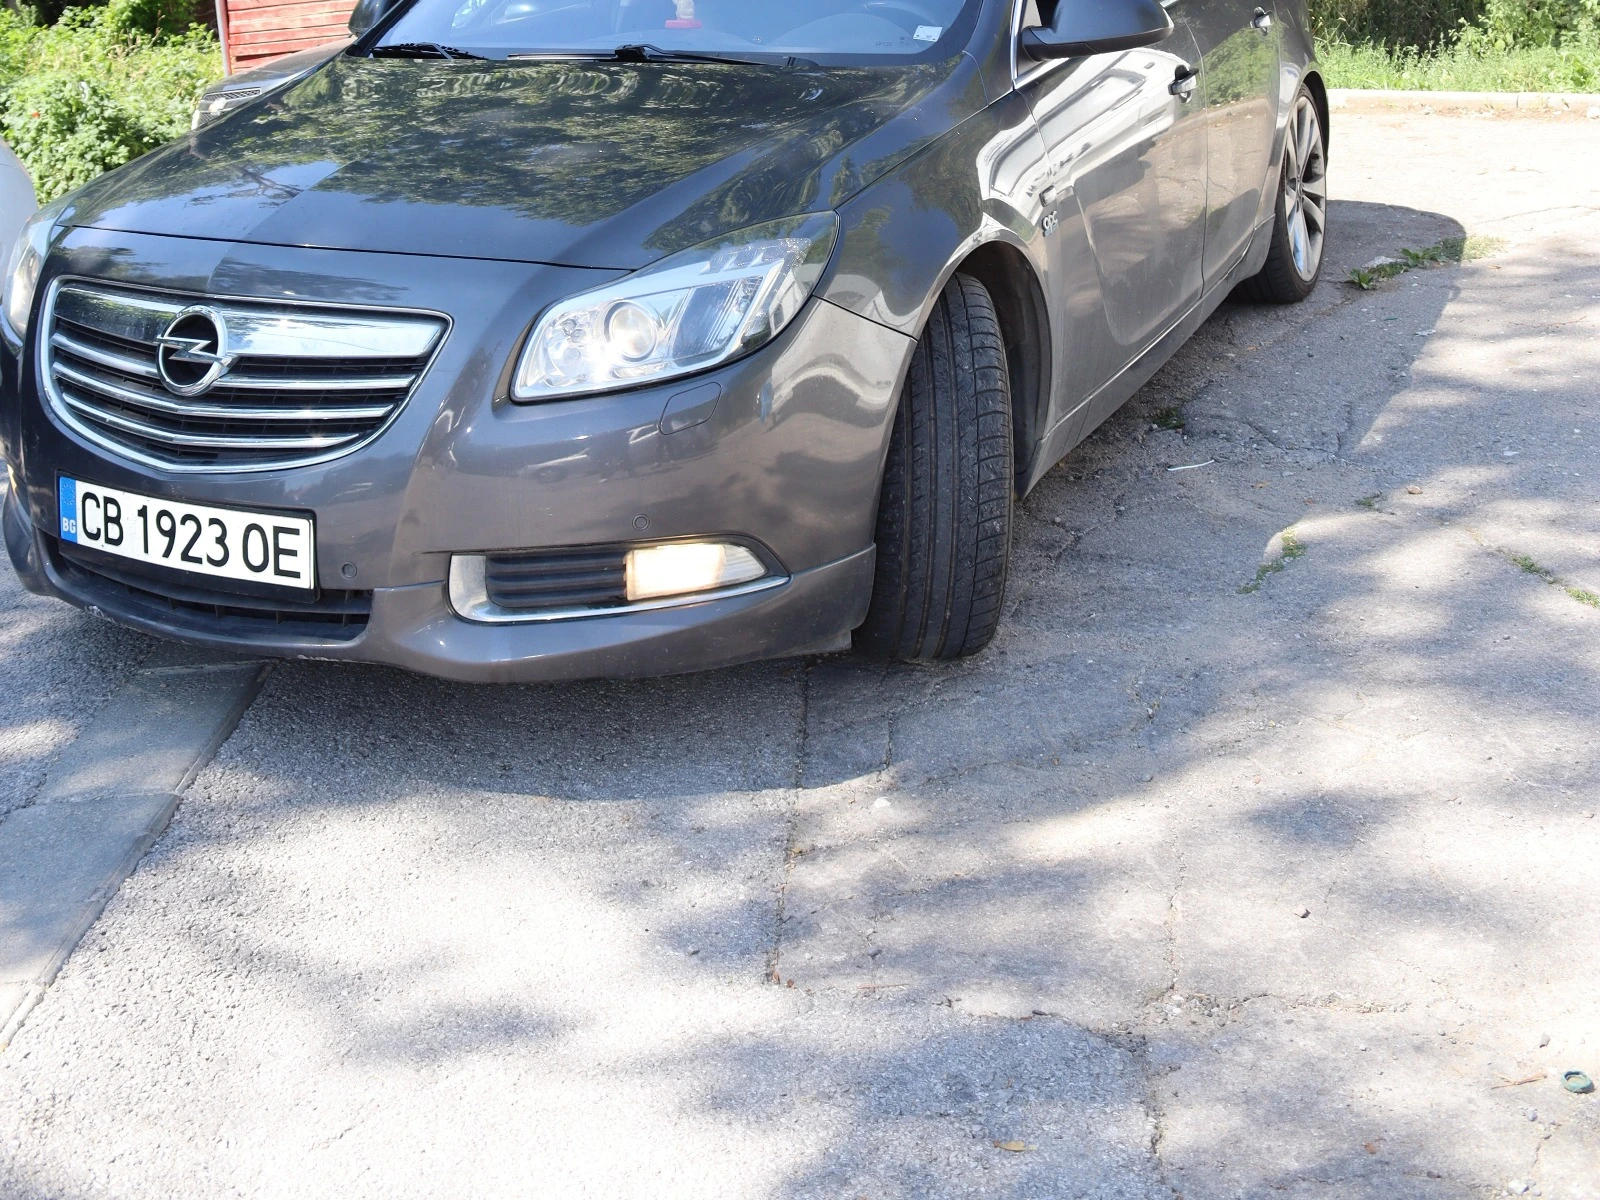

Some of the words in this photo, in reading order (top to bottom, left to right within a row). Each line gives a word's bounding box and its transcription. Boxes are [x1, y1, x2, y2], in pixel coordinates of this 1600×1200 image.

[62, 516, 76, 534] BG
[81, 492, 124, 547] CB
[137, 505, 229, 567] 1923
[242, 523, 301, 579] OE
